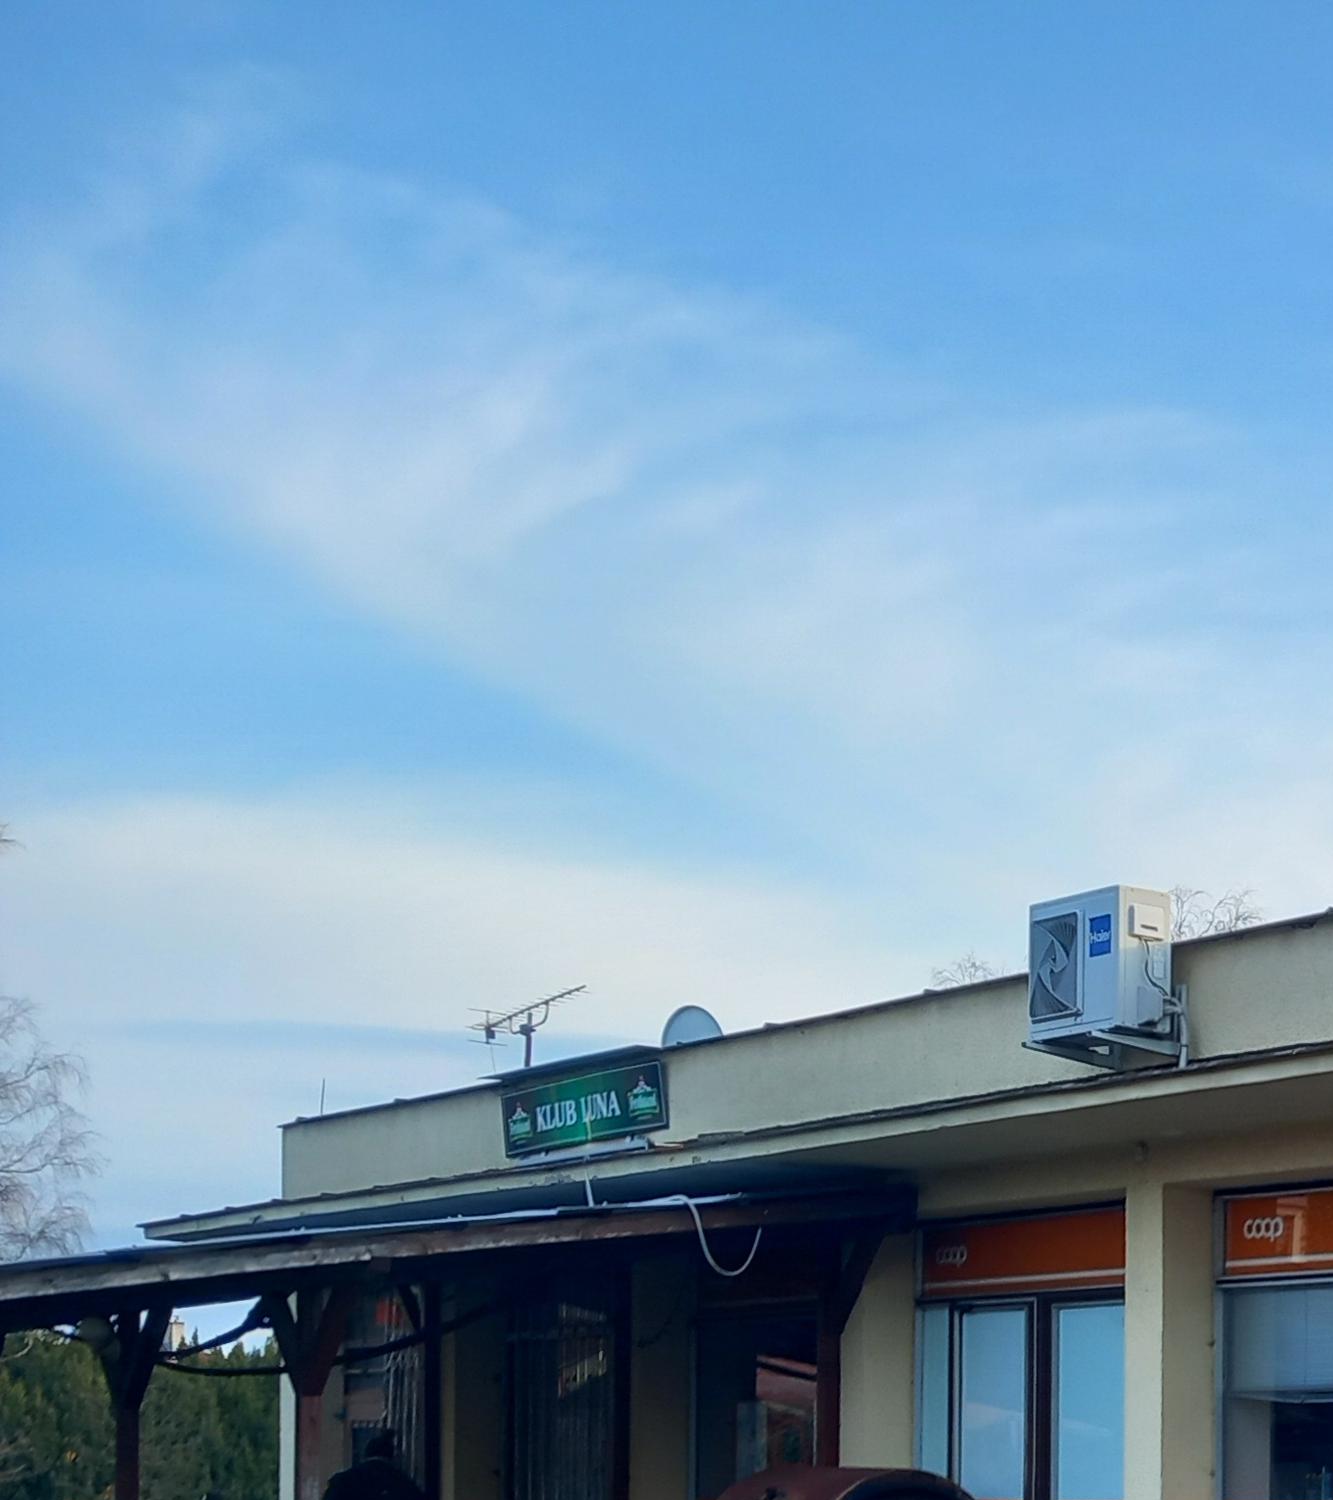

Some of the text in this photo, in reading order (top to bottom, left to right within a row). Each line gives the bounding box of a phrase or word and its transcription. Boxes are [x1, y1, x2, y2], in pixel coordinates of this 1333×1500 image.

[535, 1099, 578, 1133] KLUB
[580, 1090, 621, 1124] LUNA
[1243, 1215, 1284, 1243] coop
[936, 1245, 968, 1267] coop
